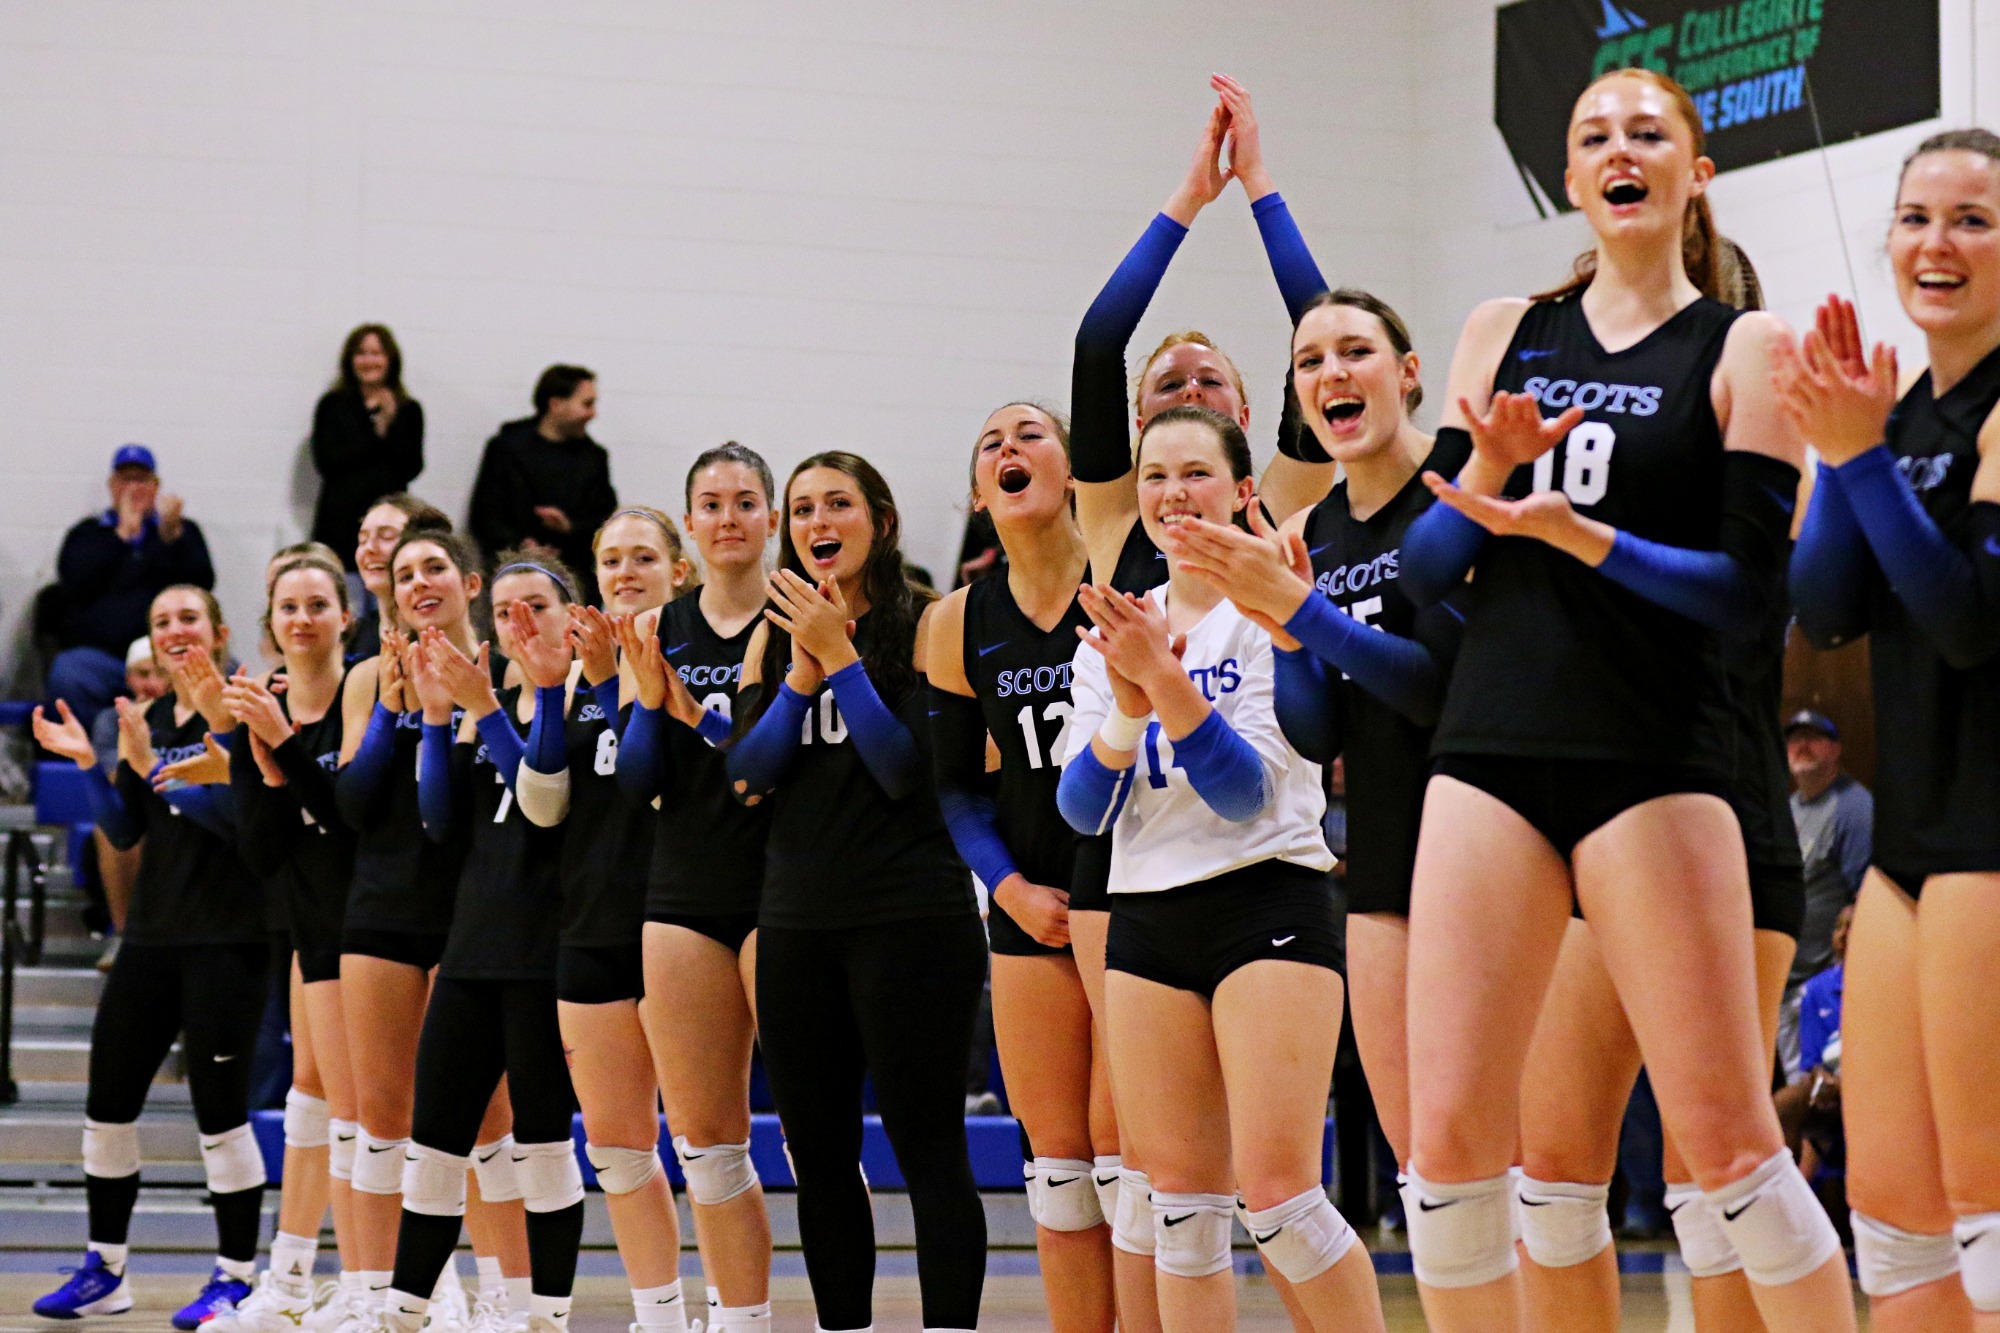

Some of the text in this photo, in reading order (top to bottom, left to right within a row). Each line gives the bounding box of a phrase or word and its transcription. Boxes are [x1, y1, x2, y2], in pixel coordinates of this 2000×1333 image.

[1718, 63, 1806, 131] SOUTH
[1523, 376, 1663, 417] SCOTS
[1533, 416, 1616, 506] 18
[1315, 549, 1400, 596] SCOTS
[677, 663, 743, 686] SCOT
[997, 661, 1074, 698] SCOT
[1017, 700, 1075, 770] 12
